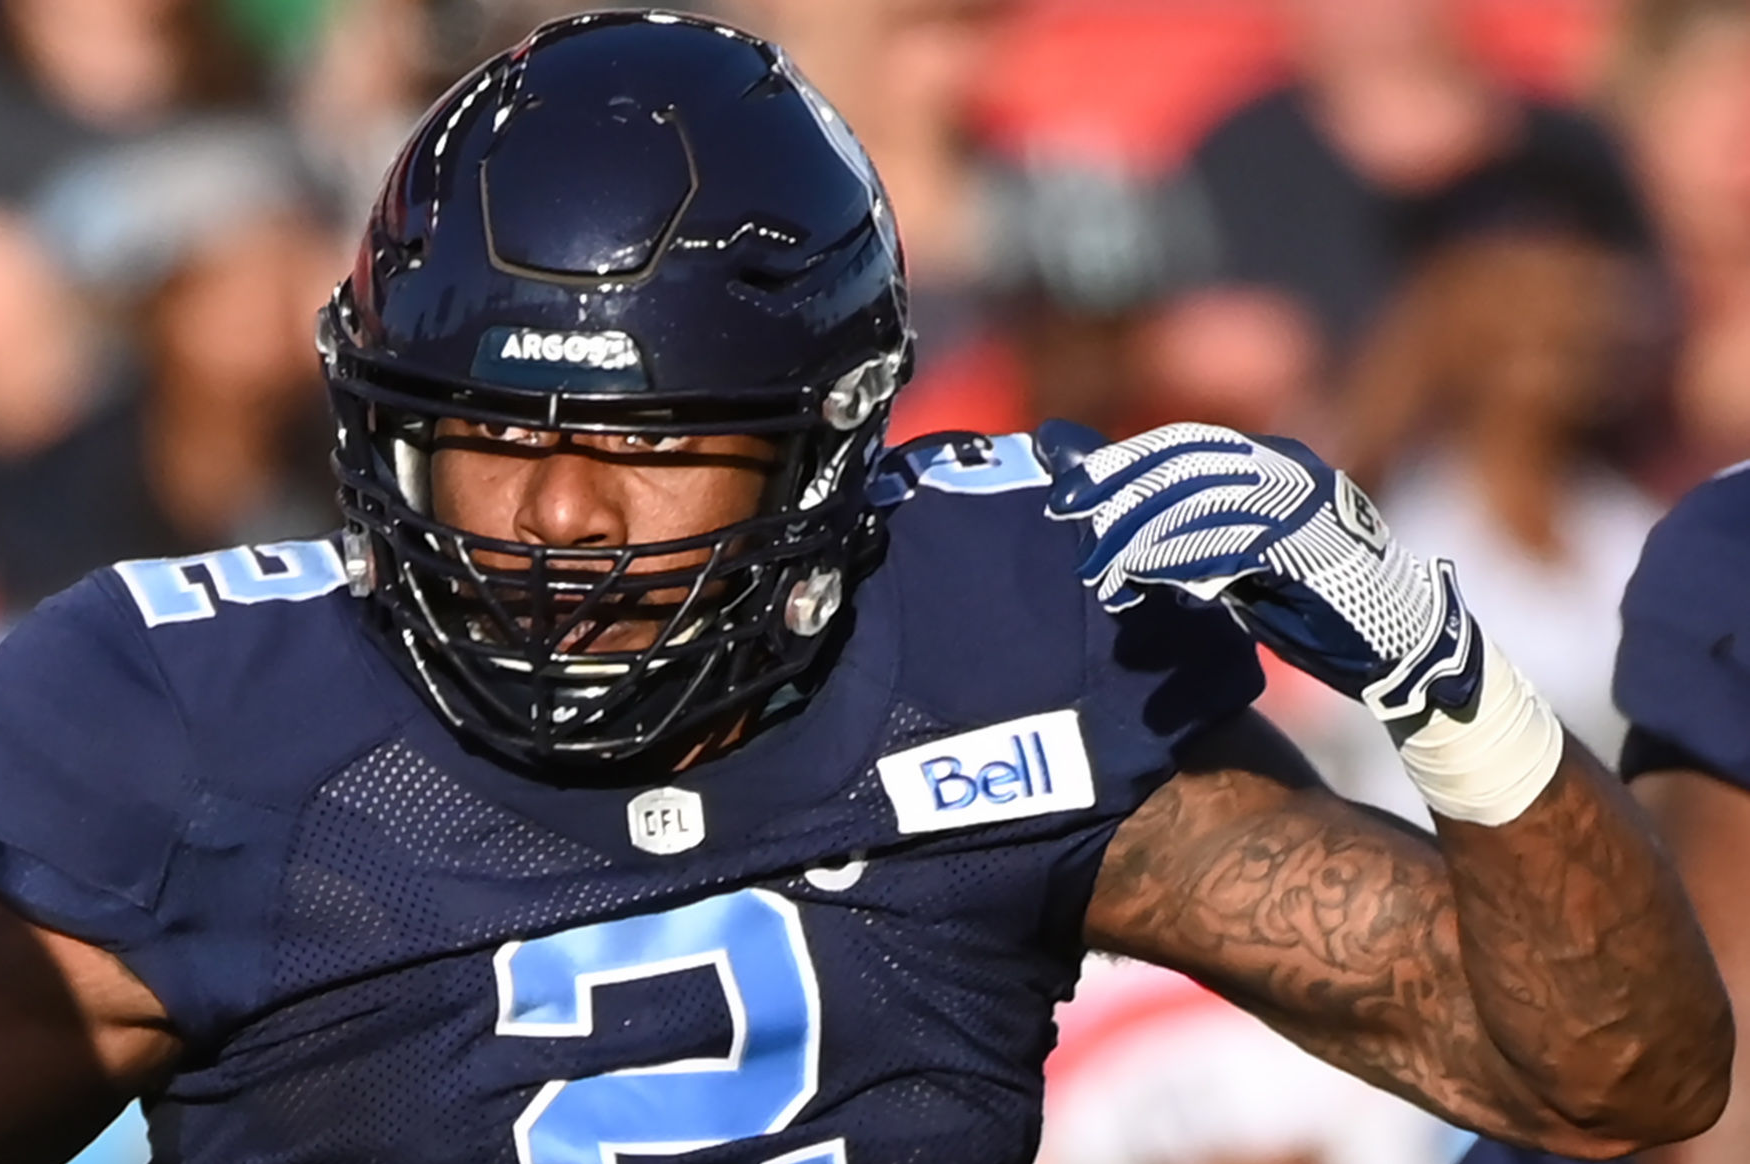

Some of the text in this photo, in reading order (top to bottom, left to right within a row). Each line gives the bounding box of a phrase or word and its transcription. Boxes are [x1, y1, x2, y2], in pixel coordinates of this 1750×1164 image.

[112, 538, 350, 629] 2
[920, 730, 1054, 812] Bell
[642, 810, 690, 837] CFL
